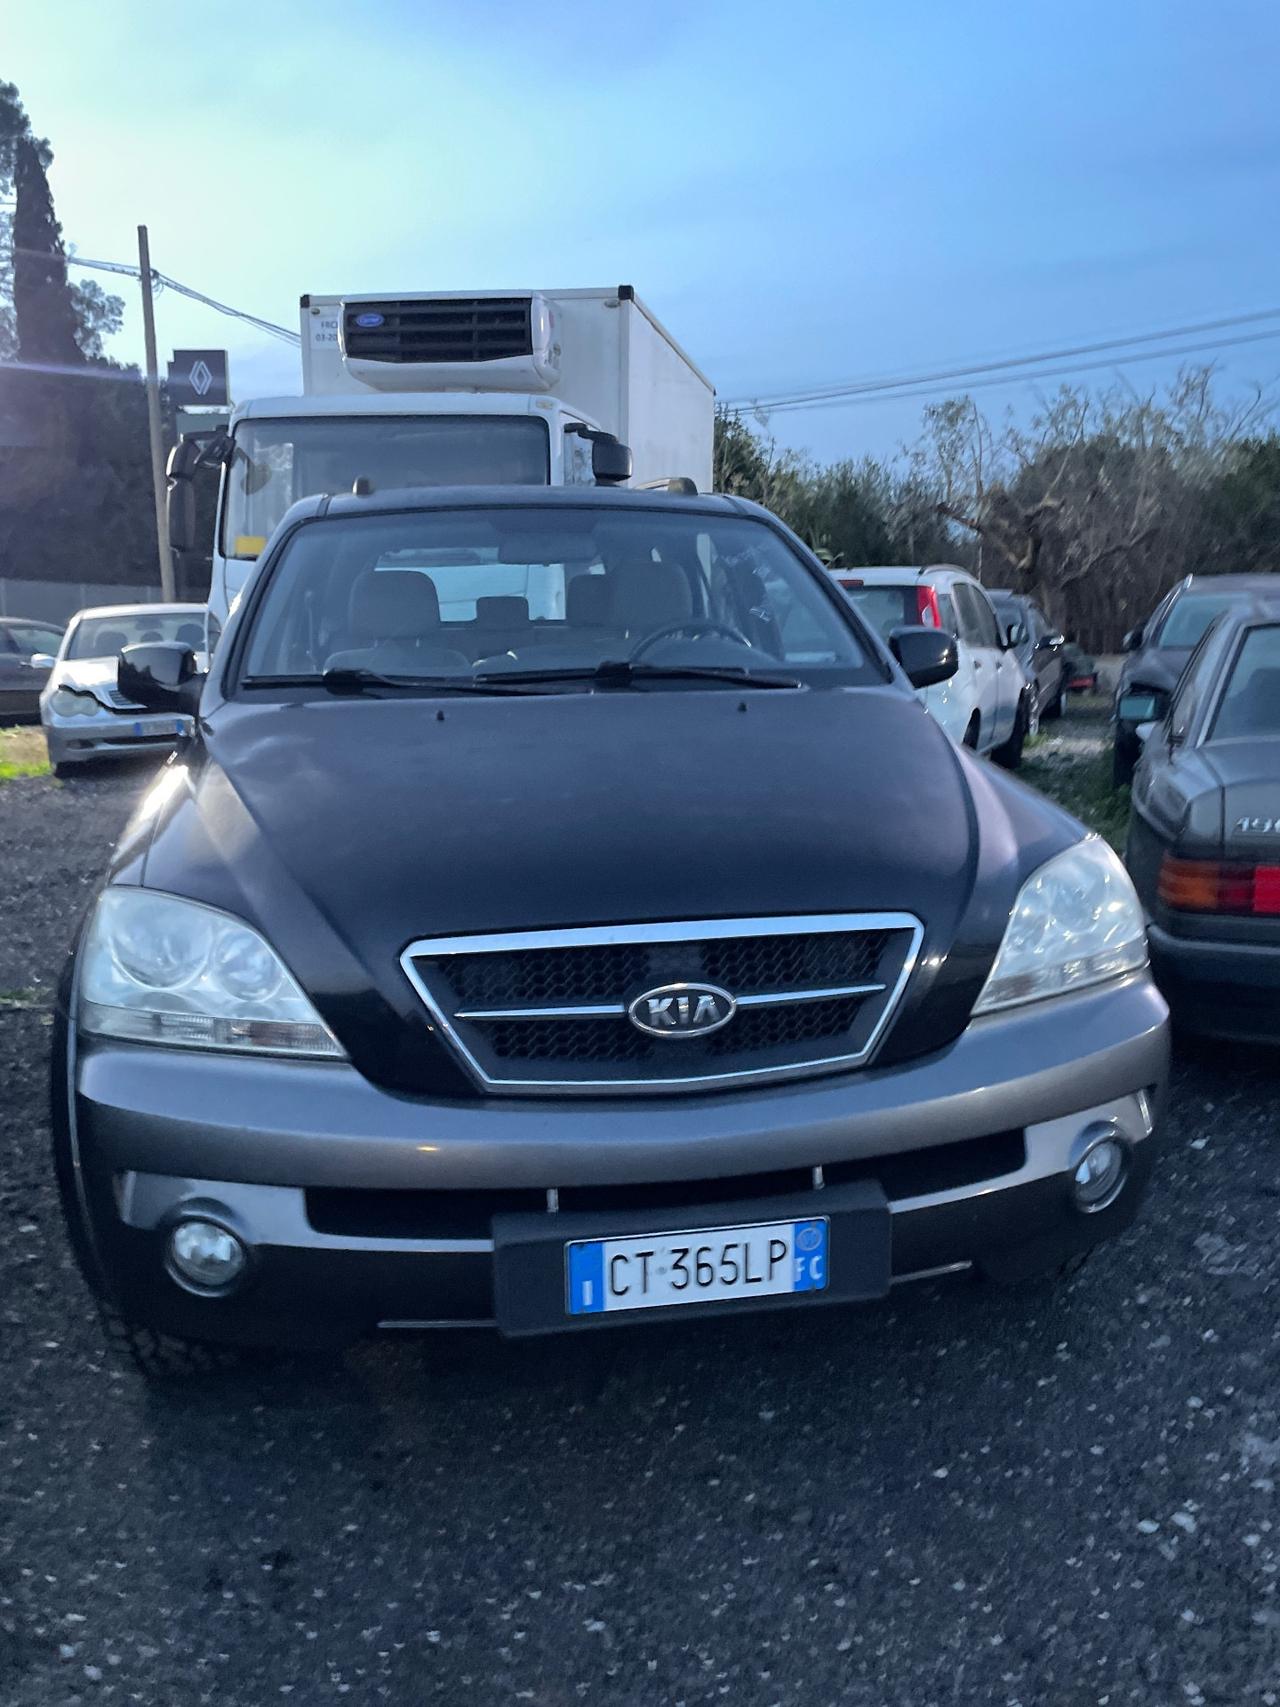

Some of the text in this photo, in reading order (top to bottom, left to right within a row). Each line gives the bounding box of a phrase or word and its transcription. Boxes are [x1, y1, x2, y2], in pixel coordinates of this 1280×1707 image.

[647, 995, 721, 1026] KIA
[610, 1251, 654, 1296] CT
[669, 1239, 787, 1290] 365LP
[795, 1255, 823, 1281] FC
